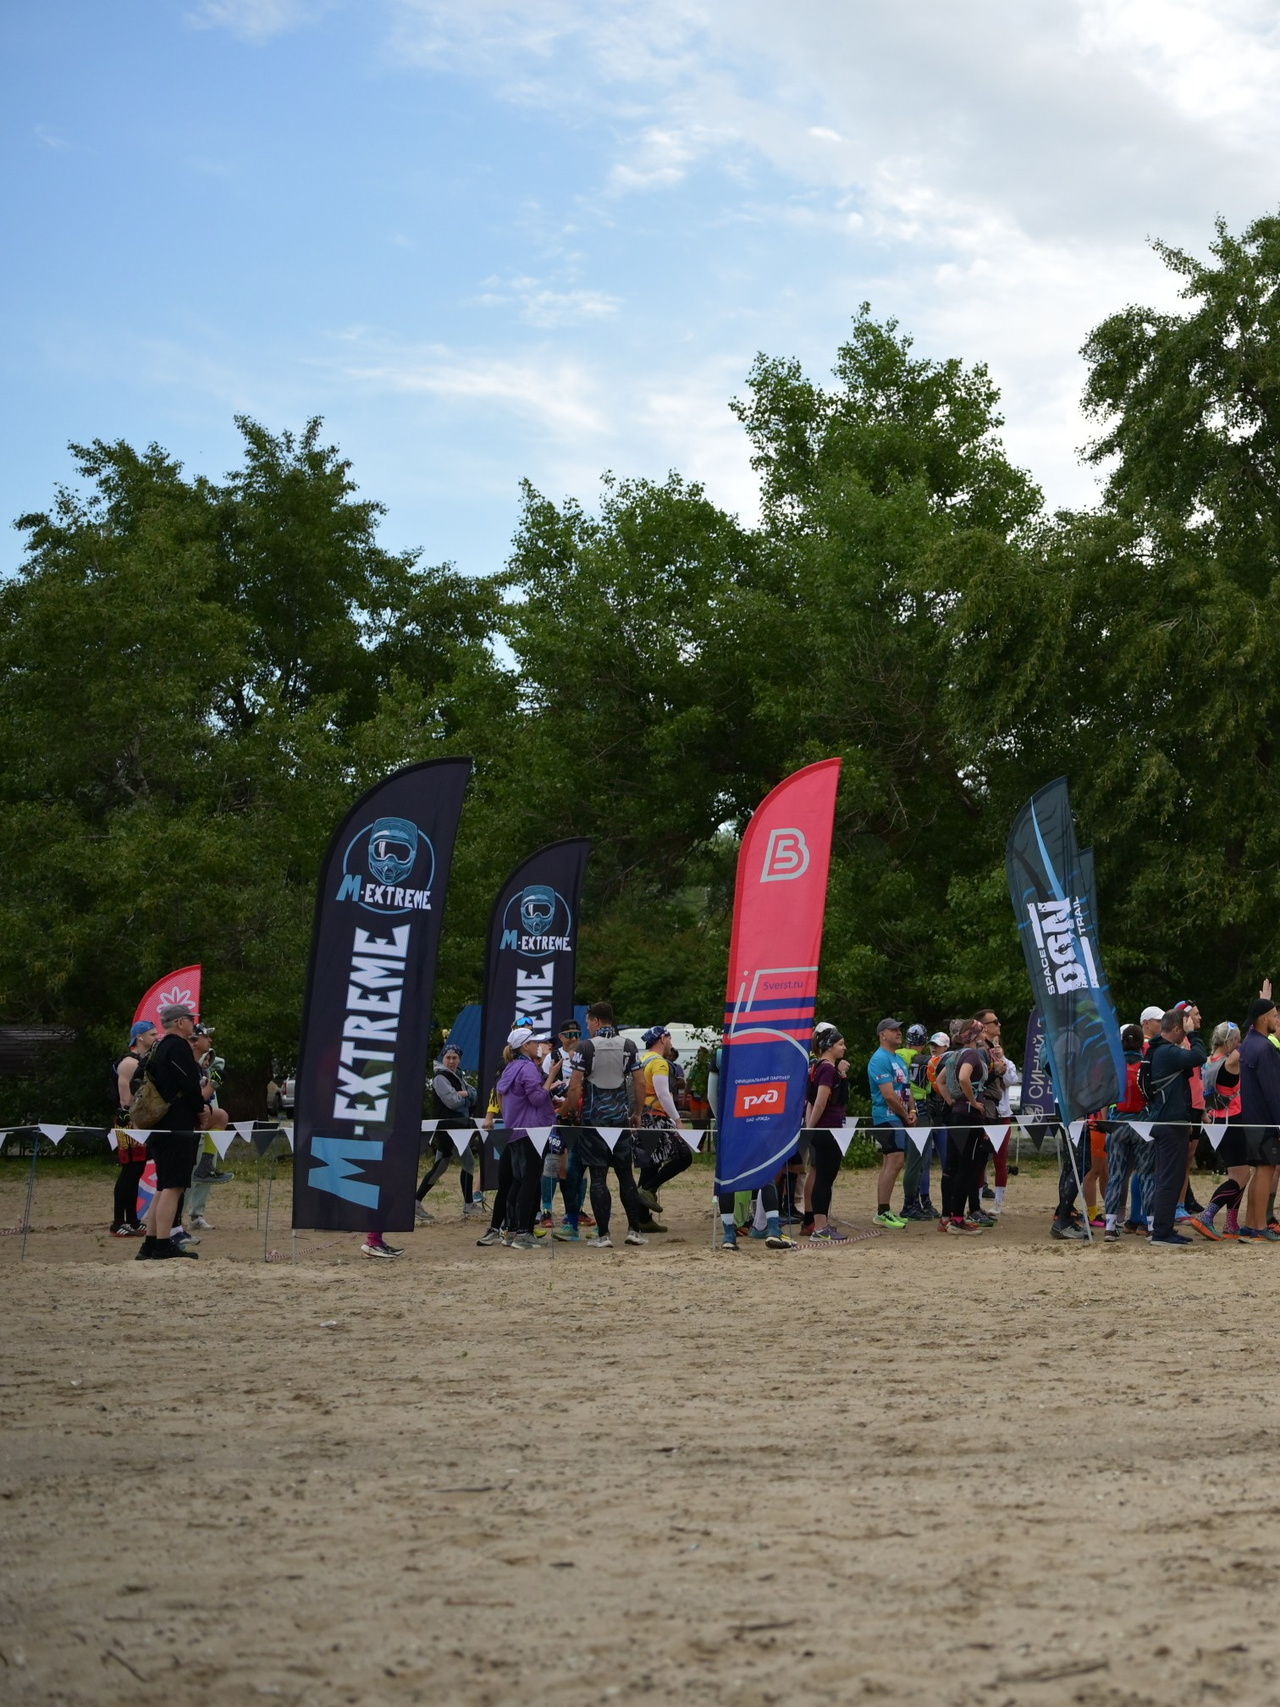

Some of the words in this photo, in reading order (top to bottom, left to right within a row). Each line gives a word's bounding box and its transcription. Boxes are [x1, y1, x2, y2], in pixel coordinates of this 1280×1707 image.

[336, 874, 431, 910] M-EXTREME
[1073, 896, 1086, 935] TRAIL
[500, 929, 572, 951] M-EXTREME
[763, 980, 804, 991] 5verst.ru
[1039, 949, 1055, 995] SPACE
[307, 924, 411, 1210] M-EXTREME
